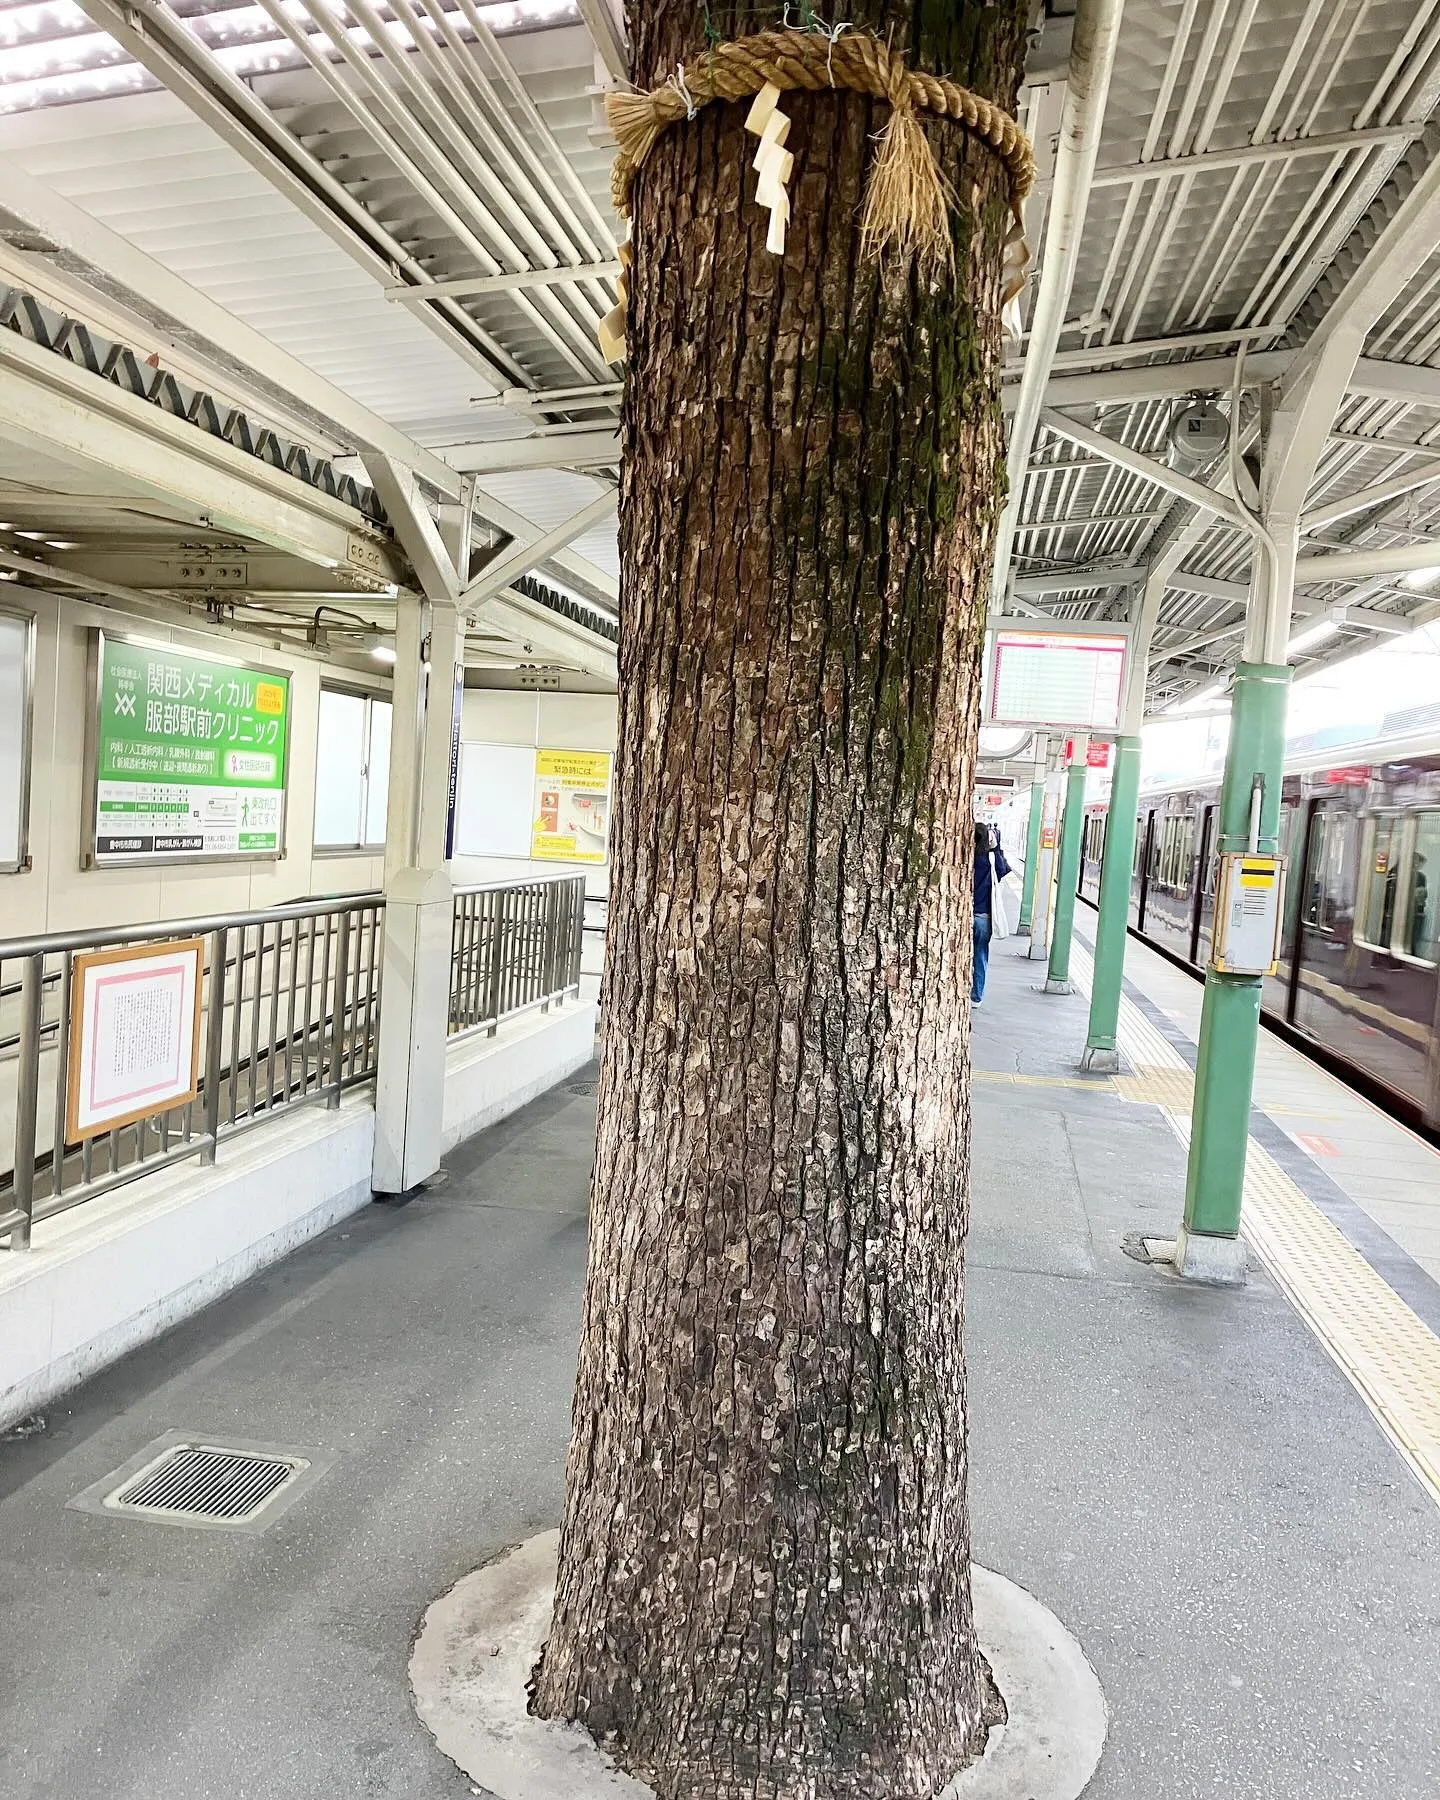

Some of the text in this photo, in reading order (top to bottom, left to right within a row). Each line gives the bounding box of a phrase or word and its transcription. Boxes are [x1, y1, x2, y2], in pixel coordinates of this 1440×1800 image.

[147, 662, 254, 709] 関西メディカル
[145, 699, 279, 745] 服部駅前クリニック
[554, 765, 592, 775] 緊急時には
[250, 812, 277, 826] 出てすぐ
